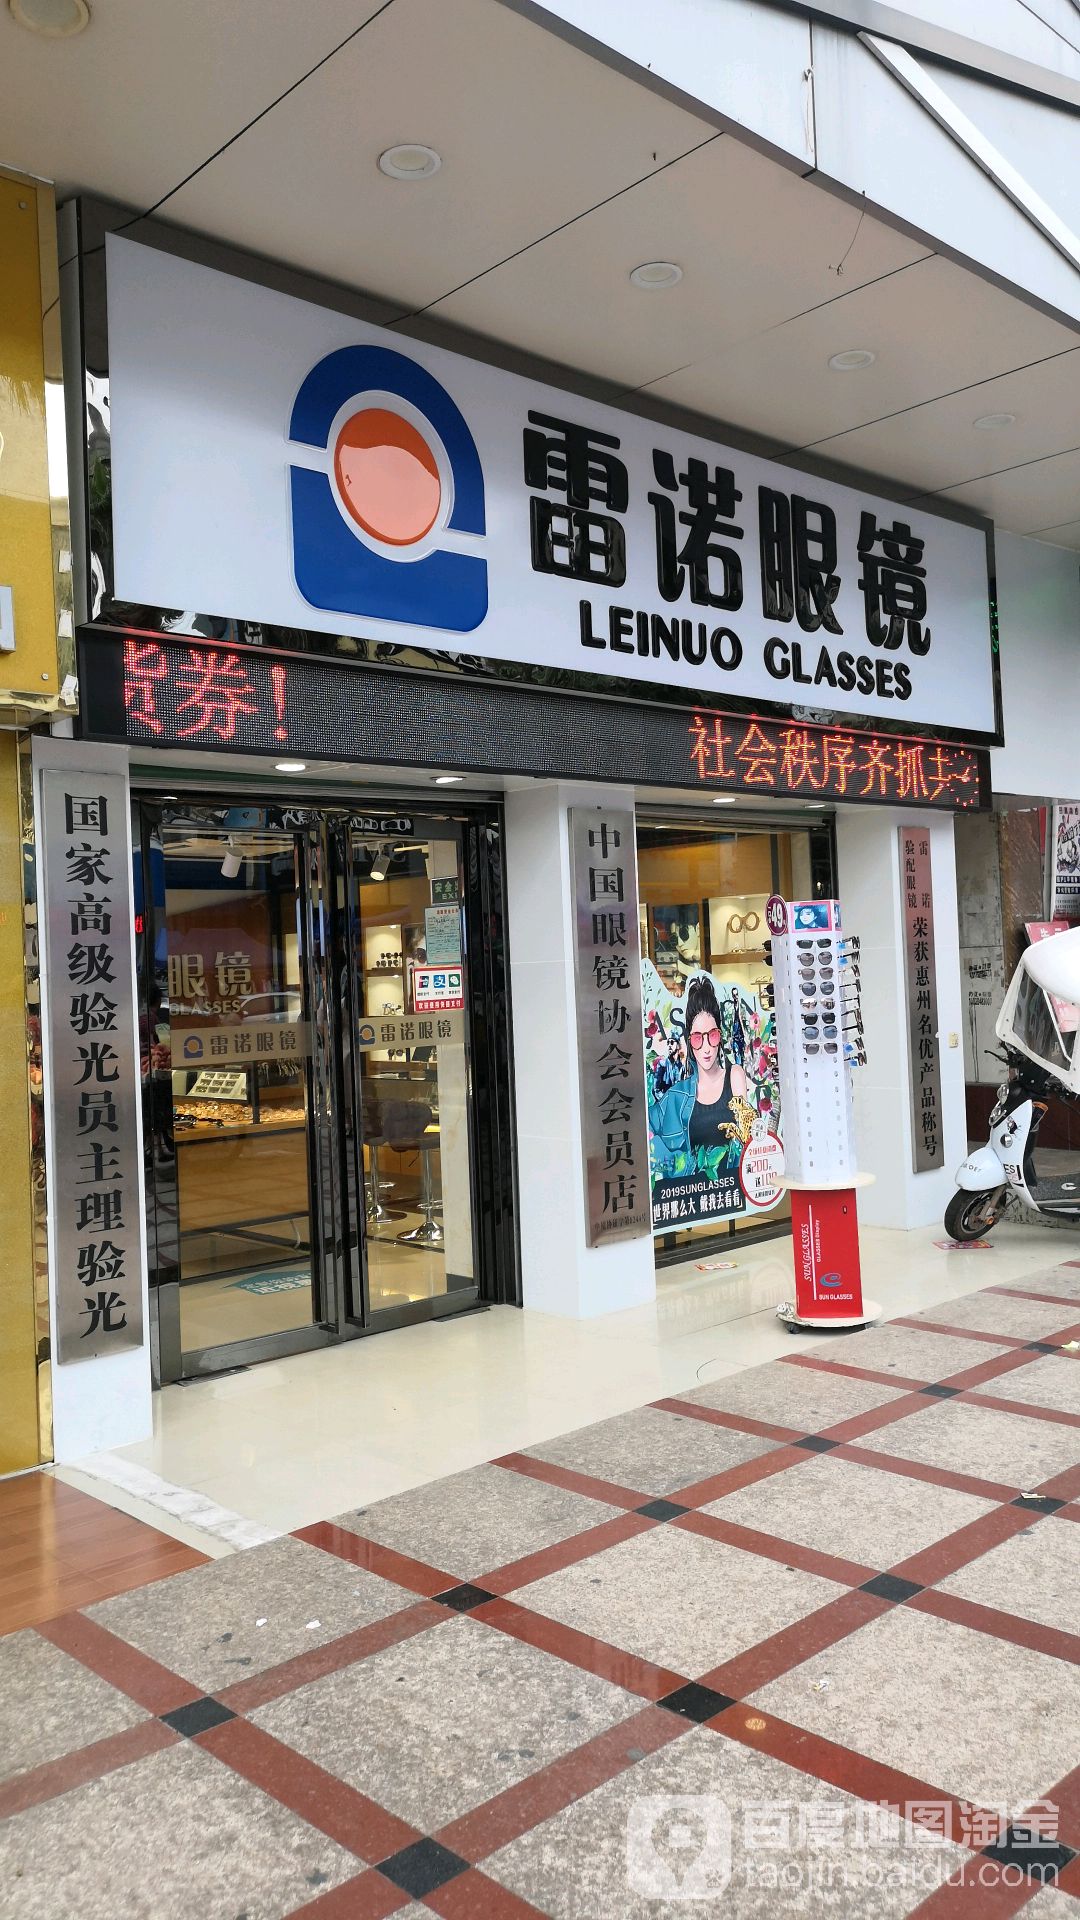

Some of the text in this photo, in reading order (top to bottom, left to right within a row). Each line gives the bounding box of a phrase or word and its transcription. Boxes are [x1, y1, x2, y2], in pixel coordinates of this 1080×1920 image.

[523, 410, 931, 657] 雷诺眼镜
[580, 599, 912, 702] LEINUO GLASSES
[771, 903, 783, 928] 49
[168, 951, 252, 998] 眼镜
[210, 1030, 297, 1056] 雷诺眼镜
[381, 1019, 452, 1042] 雷诺眼镜
[588, 822, 636, 1214] 中国眼镜协会会员店
[912, 916, 937, 1157] 荣获惠州名优产品称号
[63, 792, 127, 1339] 国家高级验光员主理验光
[653, 1197, 696, 1222] 世界那么大
[660, 1176, 735, 1199] 2019SUNGLASSES
[801, 1223, 812, 1282] SUNGLASSES
